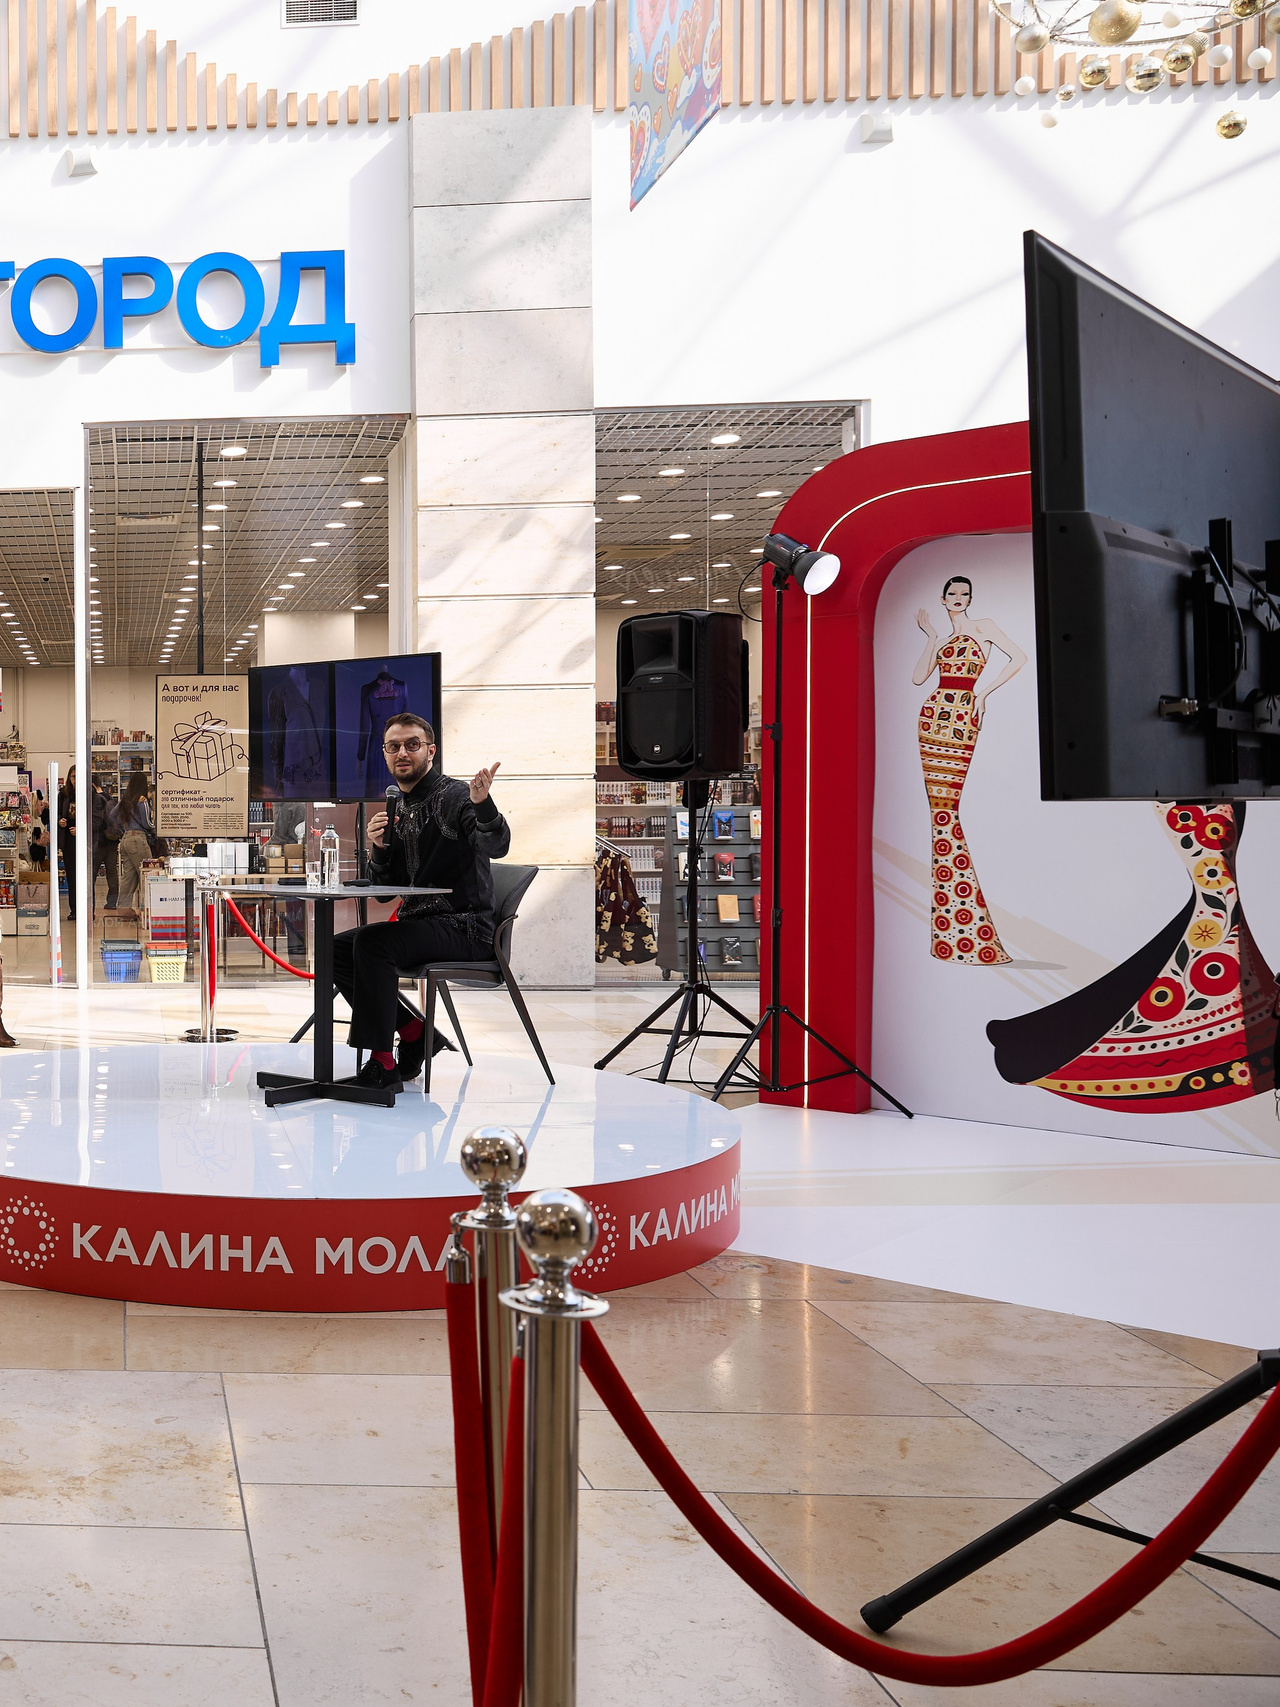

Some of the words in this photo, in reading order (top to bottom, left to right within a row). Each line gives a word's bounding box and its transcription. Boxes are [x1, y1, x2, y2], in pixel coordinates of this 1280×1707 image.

[162, 683, 170, 692] А
[201, 685, 219, 693] для
[162, 693, 202, 704] подарочек!
[629, 1185, 728, 1251] КАЛИНА
[72, 1222, 294, 1274] КАЛИНА
